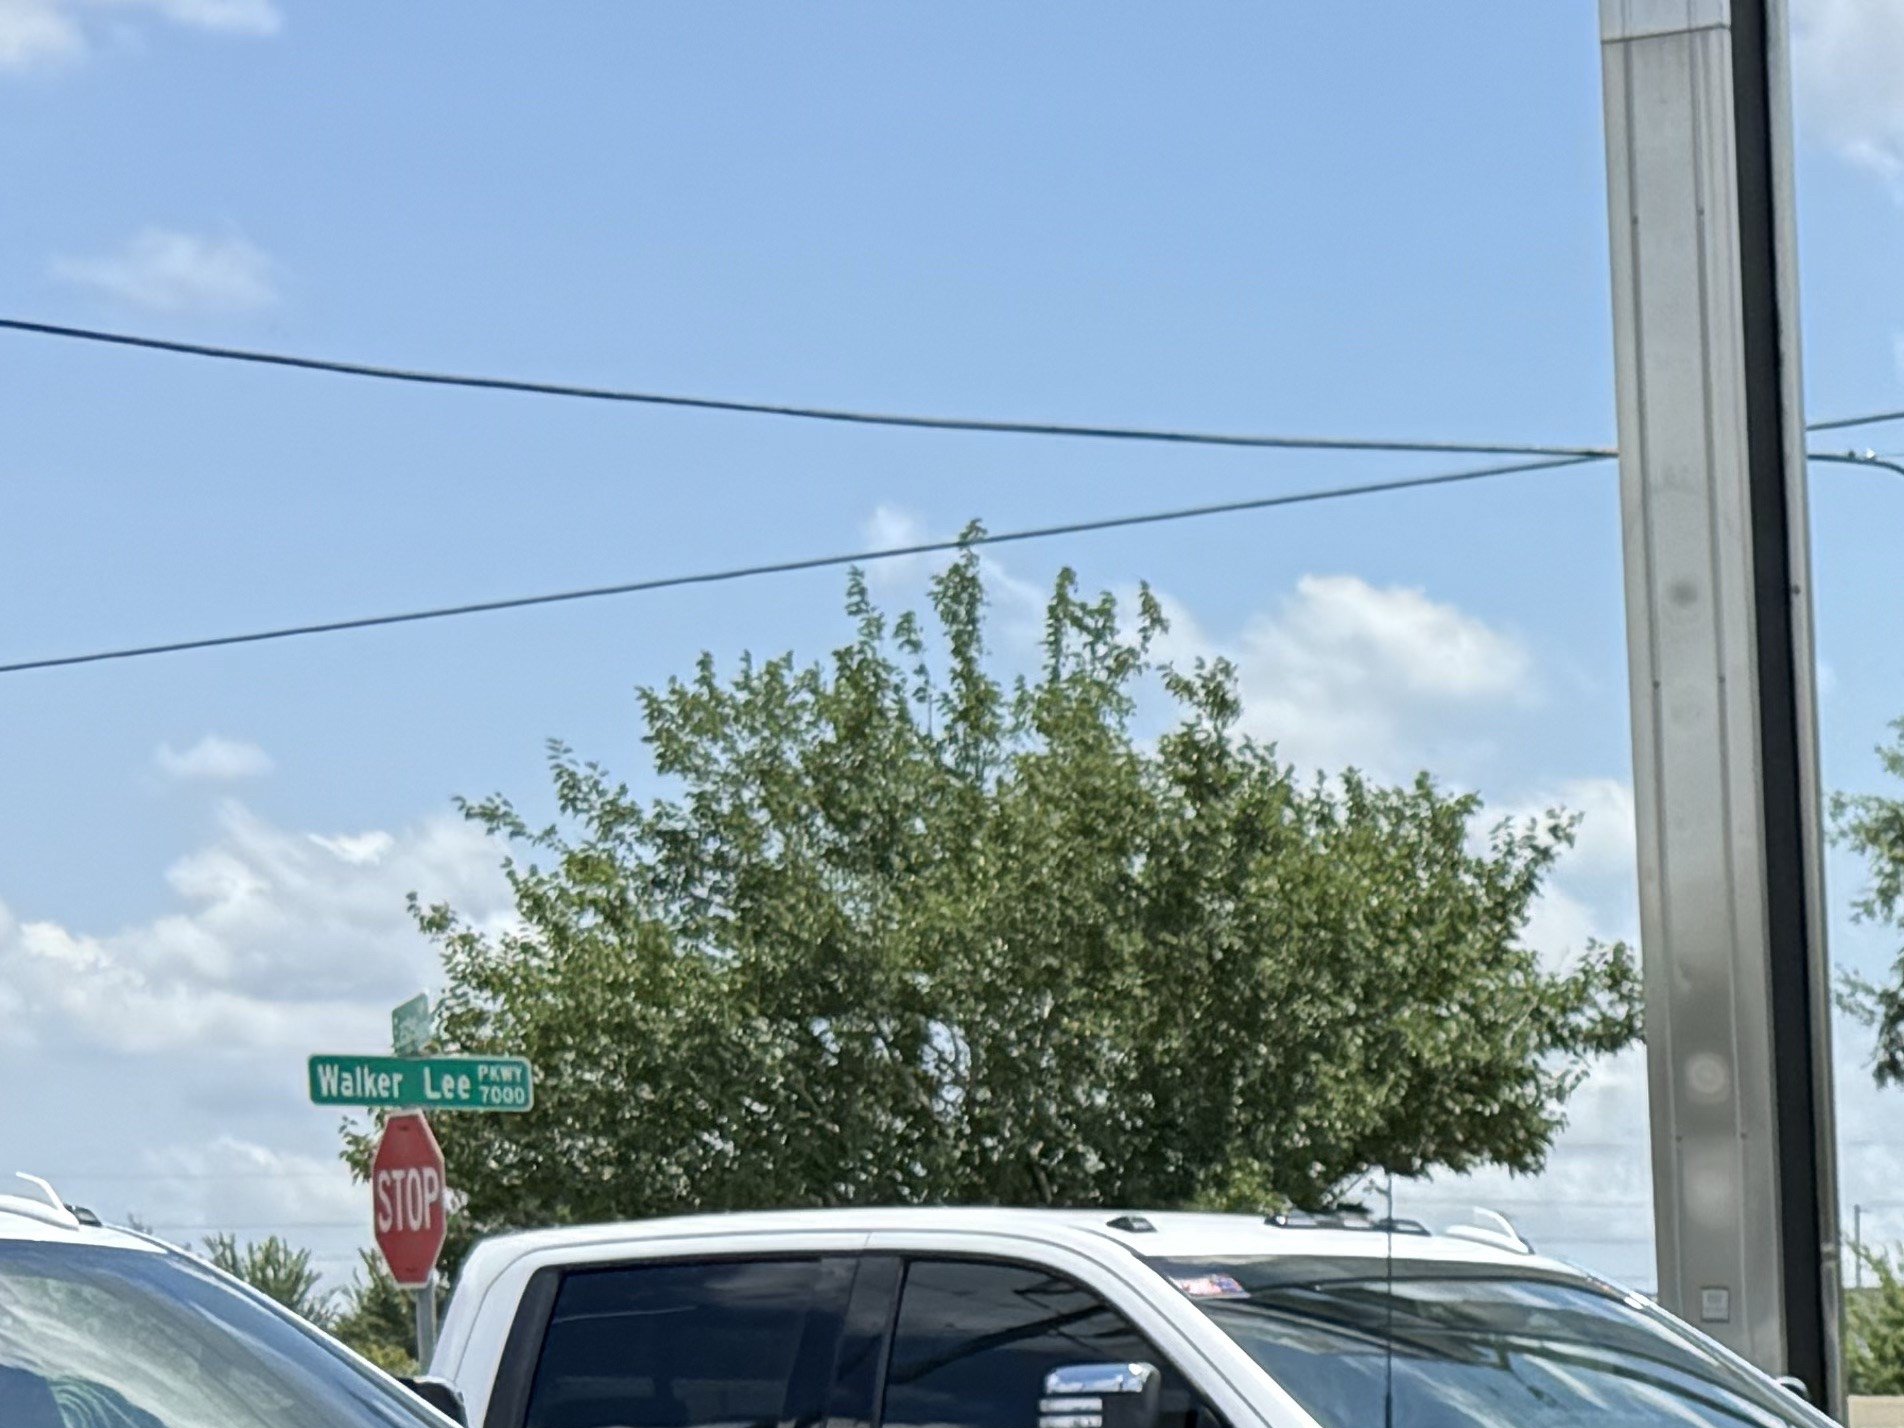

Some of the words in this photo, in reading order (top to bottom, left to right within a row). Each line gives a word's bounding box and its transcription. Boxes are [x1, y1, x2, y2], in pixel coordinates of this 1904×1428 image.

[317, 1063, 403, 1098] Walker
[423, 1067, 471, 1100] Lee
[477, 1065, 522, 1083] PKWY
[479, 1086, 525, 1104] 7000
[376, 1166, 440, 1234] STOP
